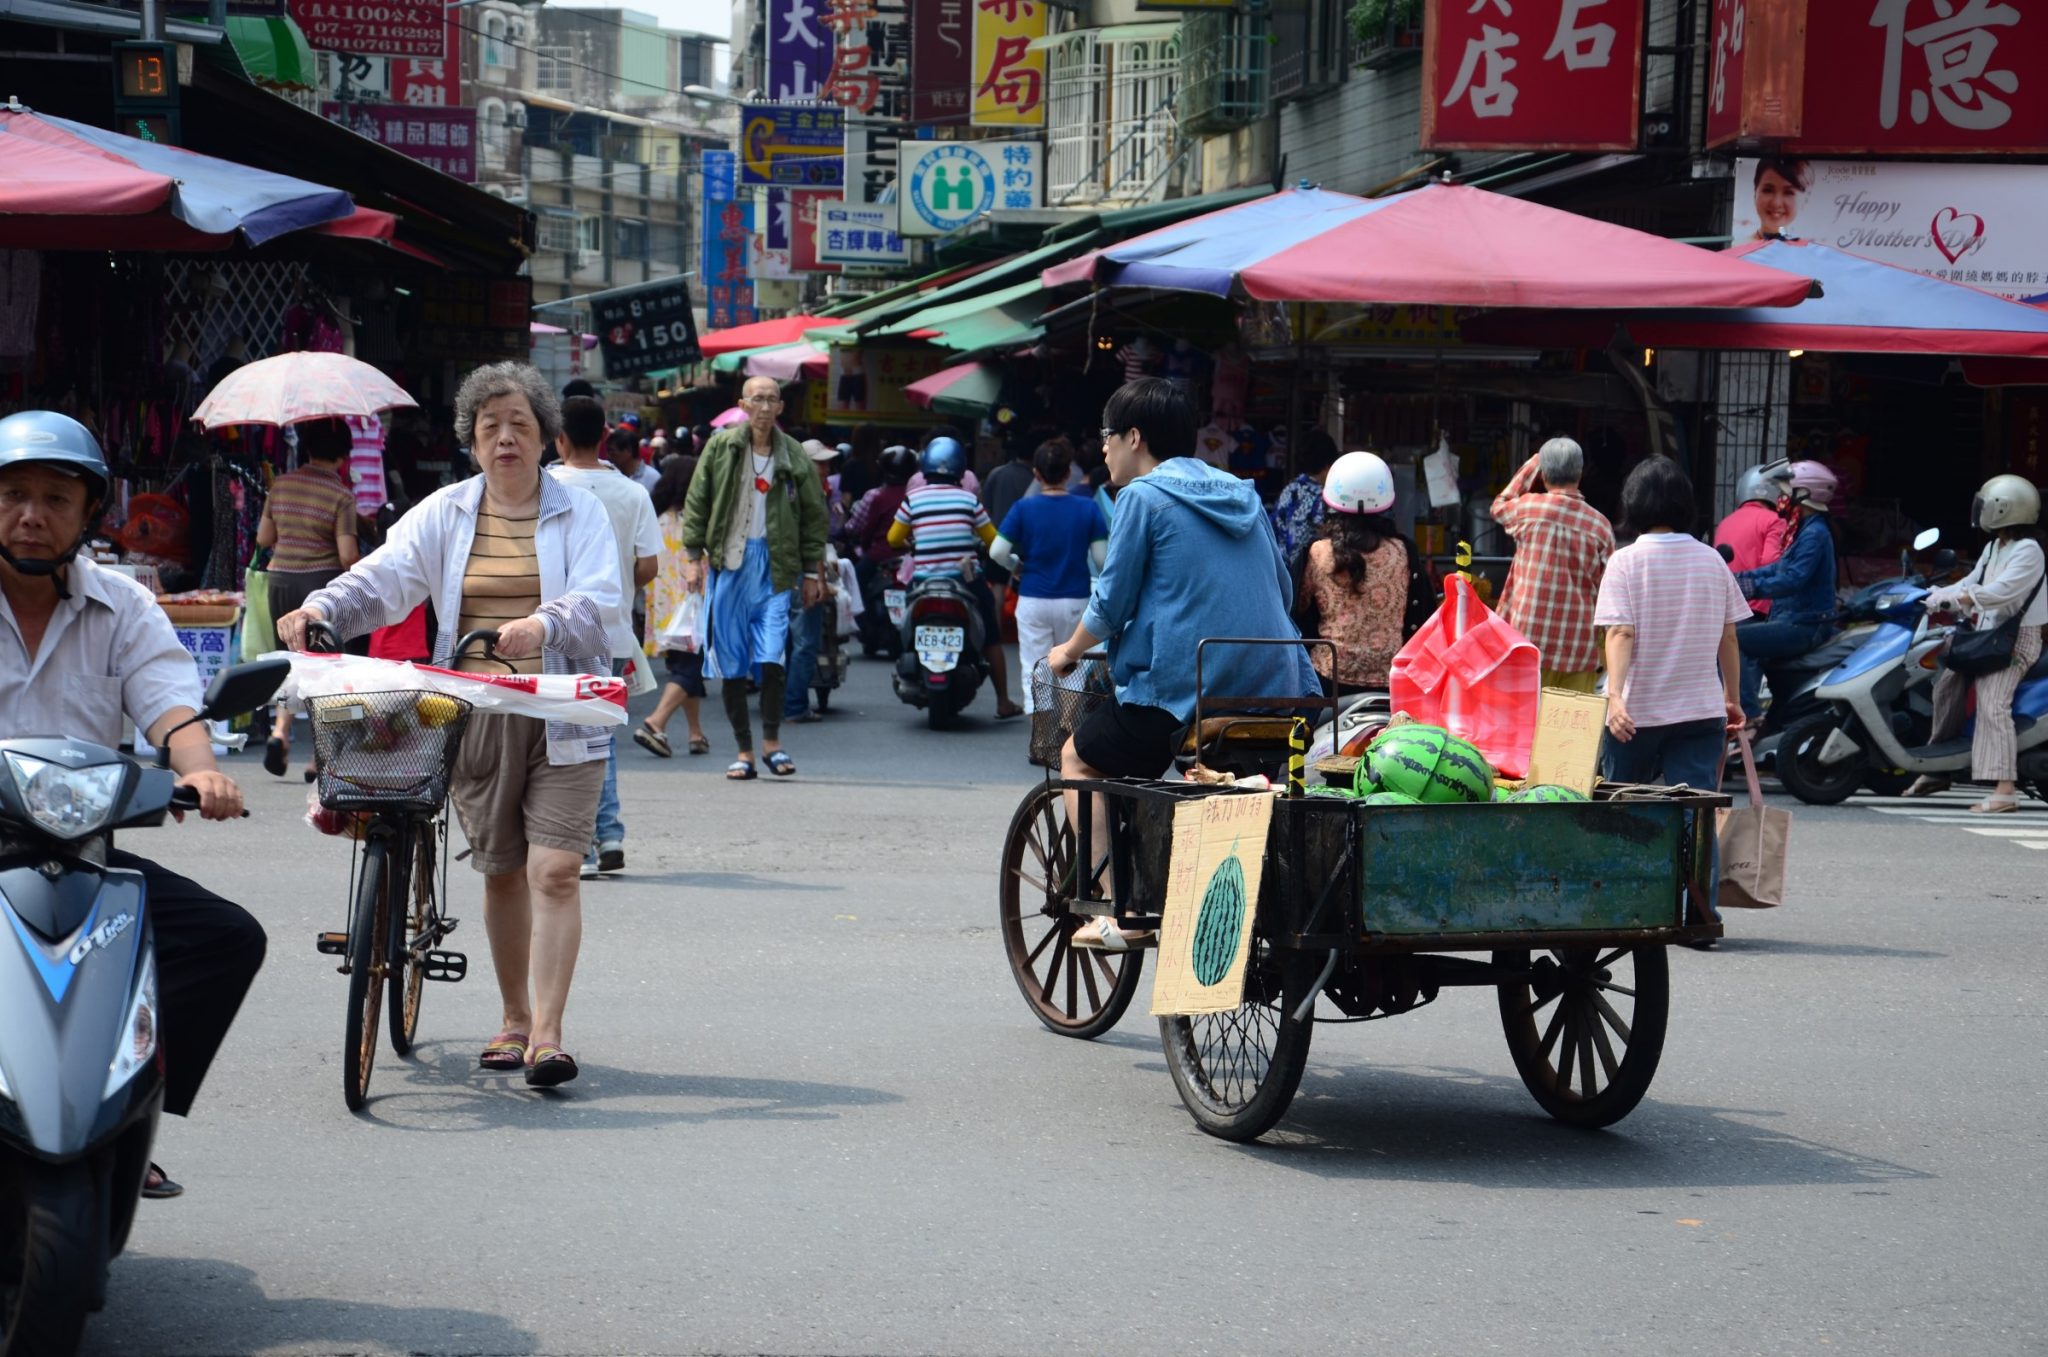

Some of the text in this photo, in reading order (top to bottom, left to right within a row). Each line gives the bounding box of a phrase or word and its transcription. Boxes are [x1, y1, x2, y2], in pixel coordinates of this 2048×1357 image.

[138, 57, 161, 93] 13
[1868, 0, 2020, 129] 億
[1834, 190, 1901, 222] Happy
[1837, 227, 1987, 256] Mother's Day
[635, 321, 687, 350] 150
